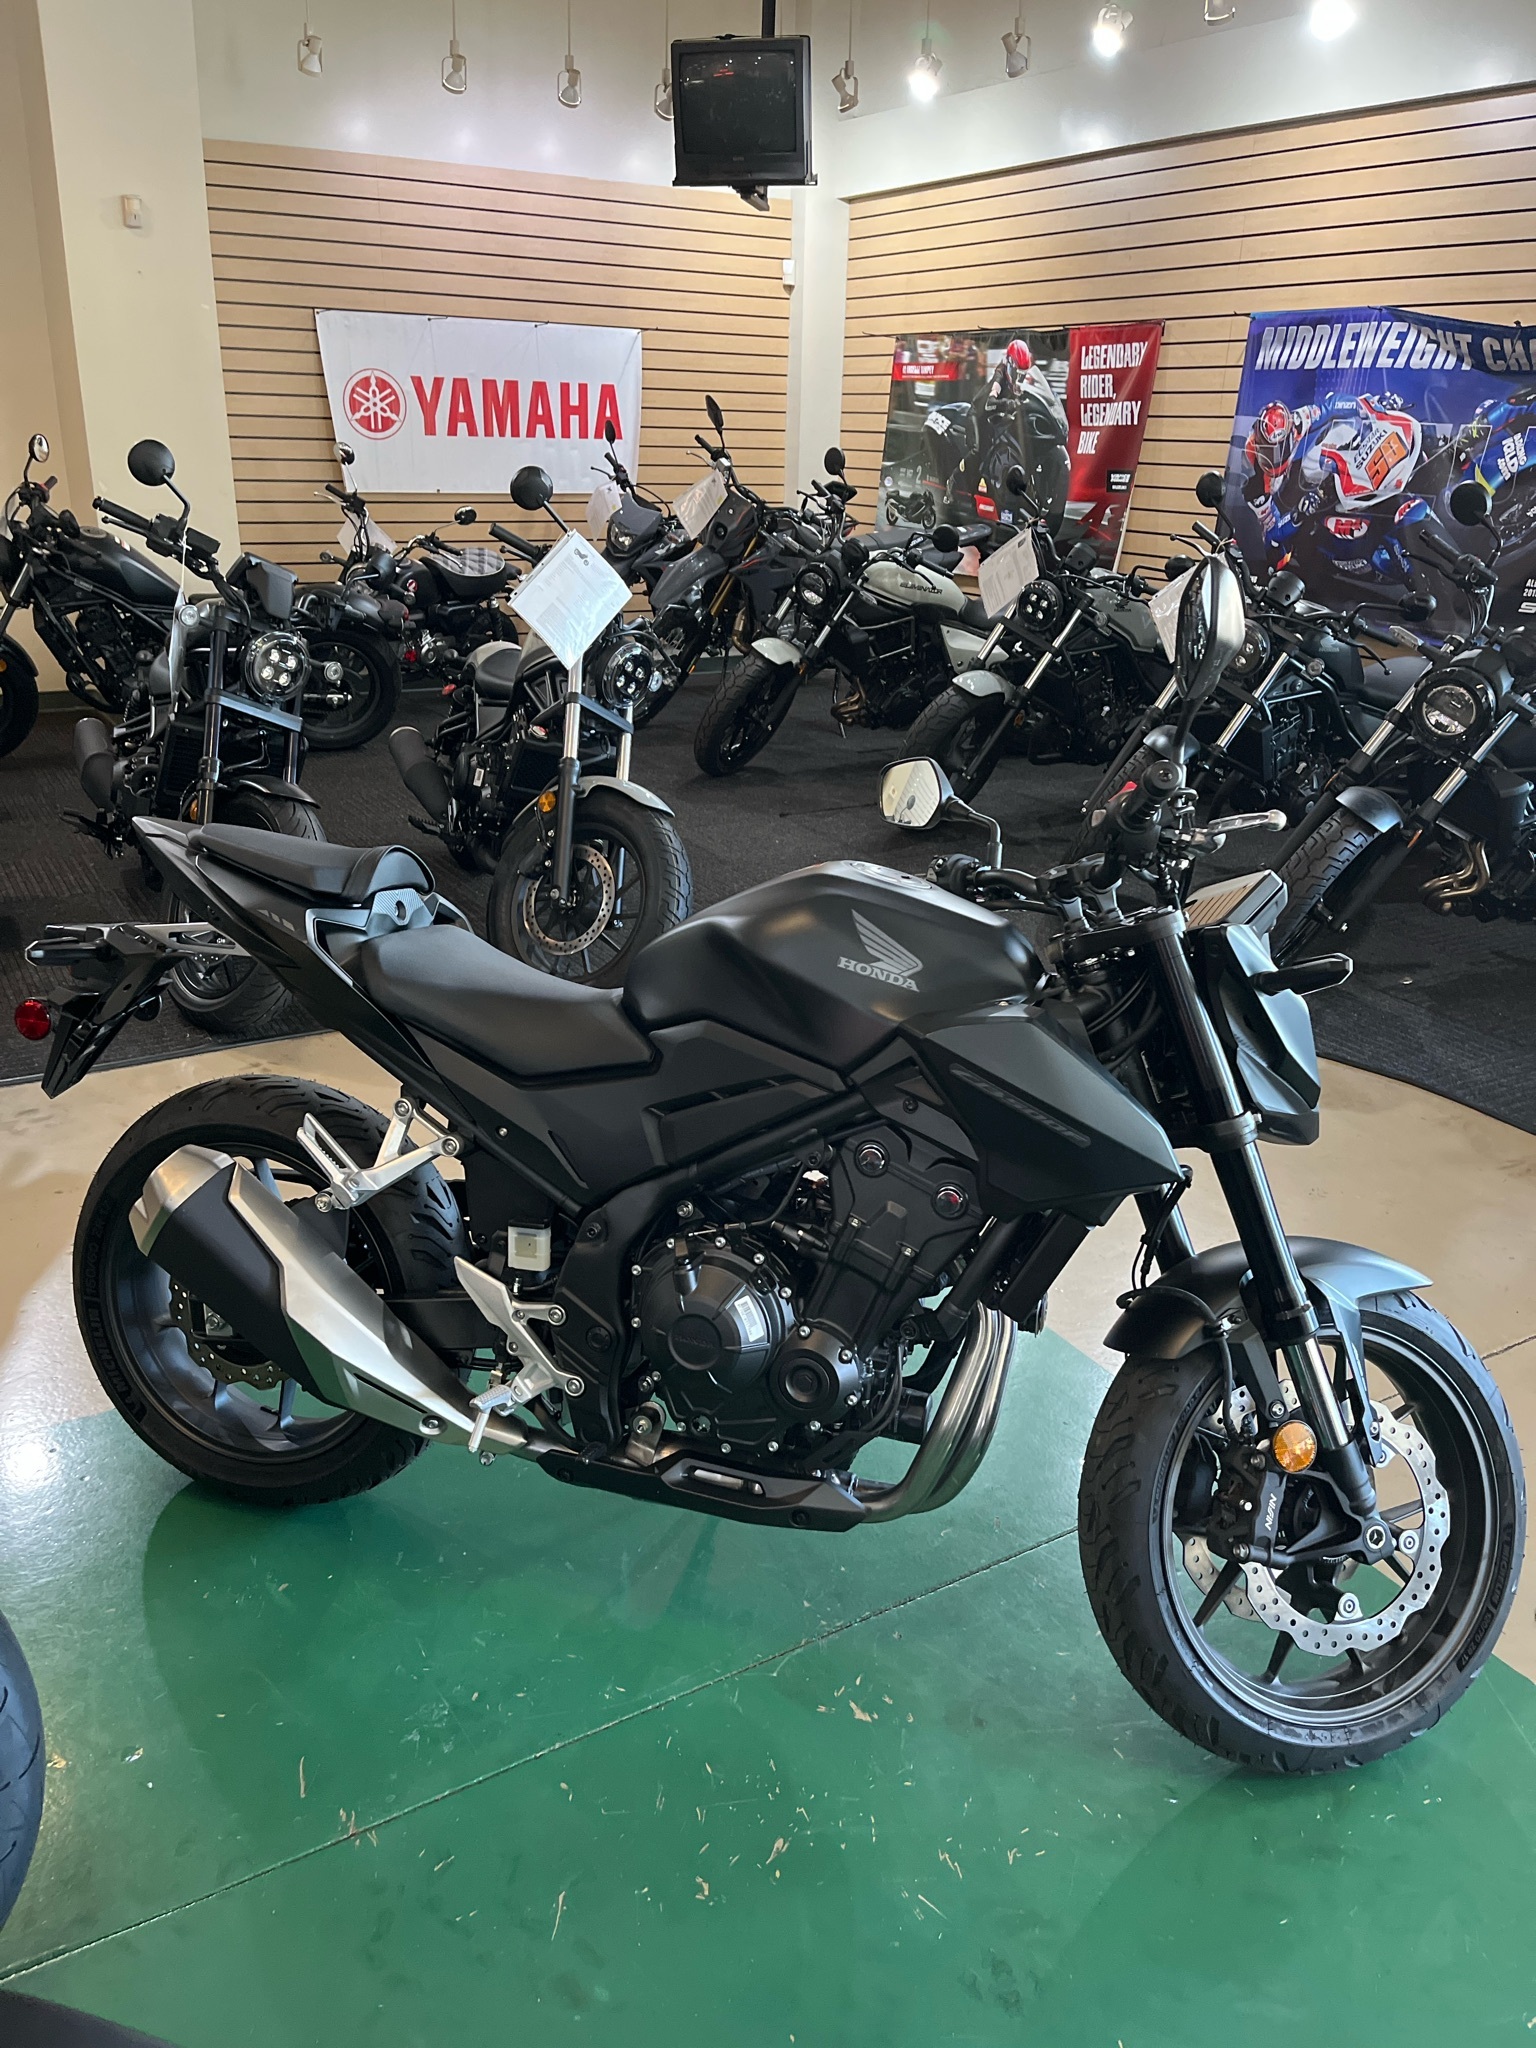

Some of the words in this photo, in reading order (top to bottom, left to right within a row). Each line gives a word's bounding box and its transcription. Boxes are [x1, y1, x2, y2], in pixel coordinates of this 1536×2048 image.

[1081, 341, 1148, 370] LEGENDARY
[1255, 321, 1472, 371] MIDDLEWEIGHT
[1080, 373, 1116, 399] RIDER,
[410, 375, 623, 440] YAMAHA
[1080, 401, 1142, 427] LEGENDARY
[1077, 431, 1100, 454] BIKE
[1355, 430, 1388, 470] SUZUKI
[900, 582, 943, 594] ELIMINATOR
[837, 956, 920, 992] HONDA
